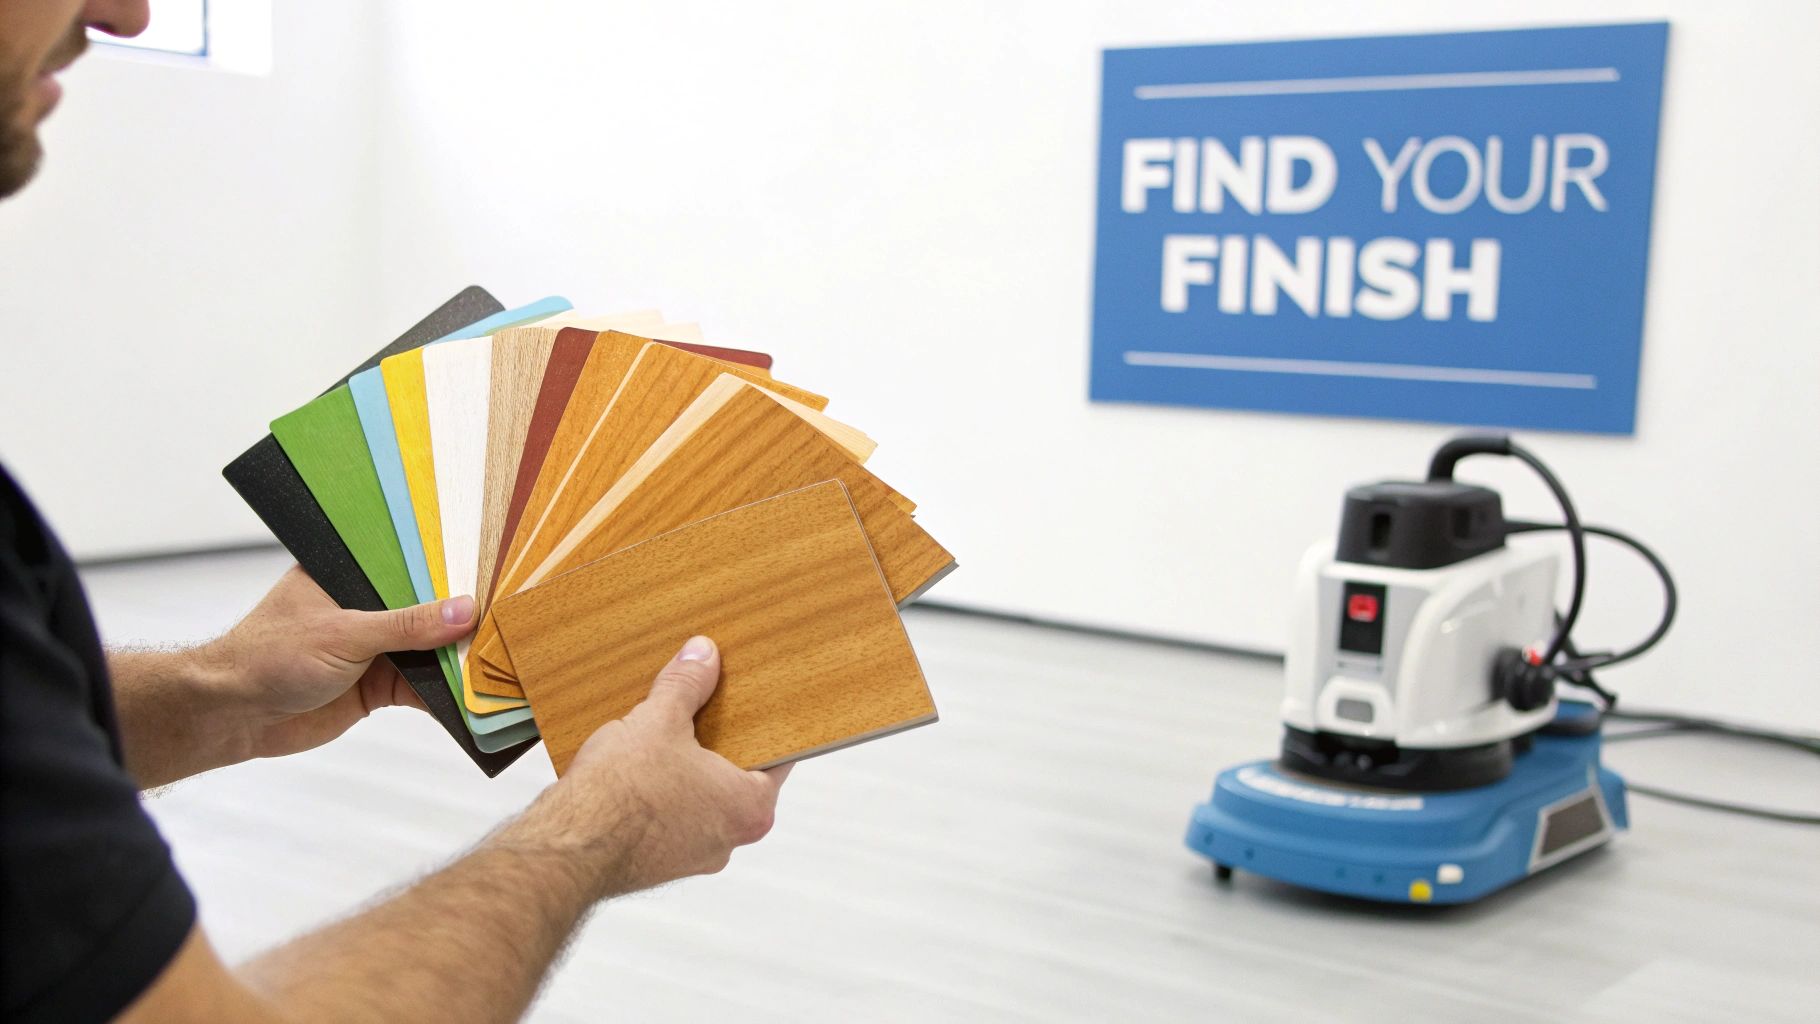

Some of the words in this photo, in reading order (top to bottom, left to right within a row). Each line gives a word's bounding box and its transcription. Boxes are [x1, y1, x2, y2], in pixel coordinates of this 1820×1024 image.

[1121, 135, 1338, 215] FIND
[1363, 134, 1609, 214] YOUR
[1161, 234, 1502, 321] FINISH
